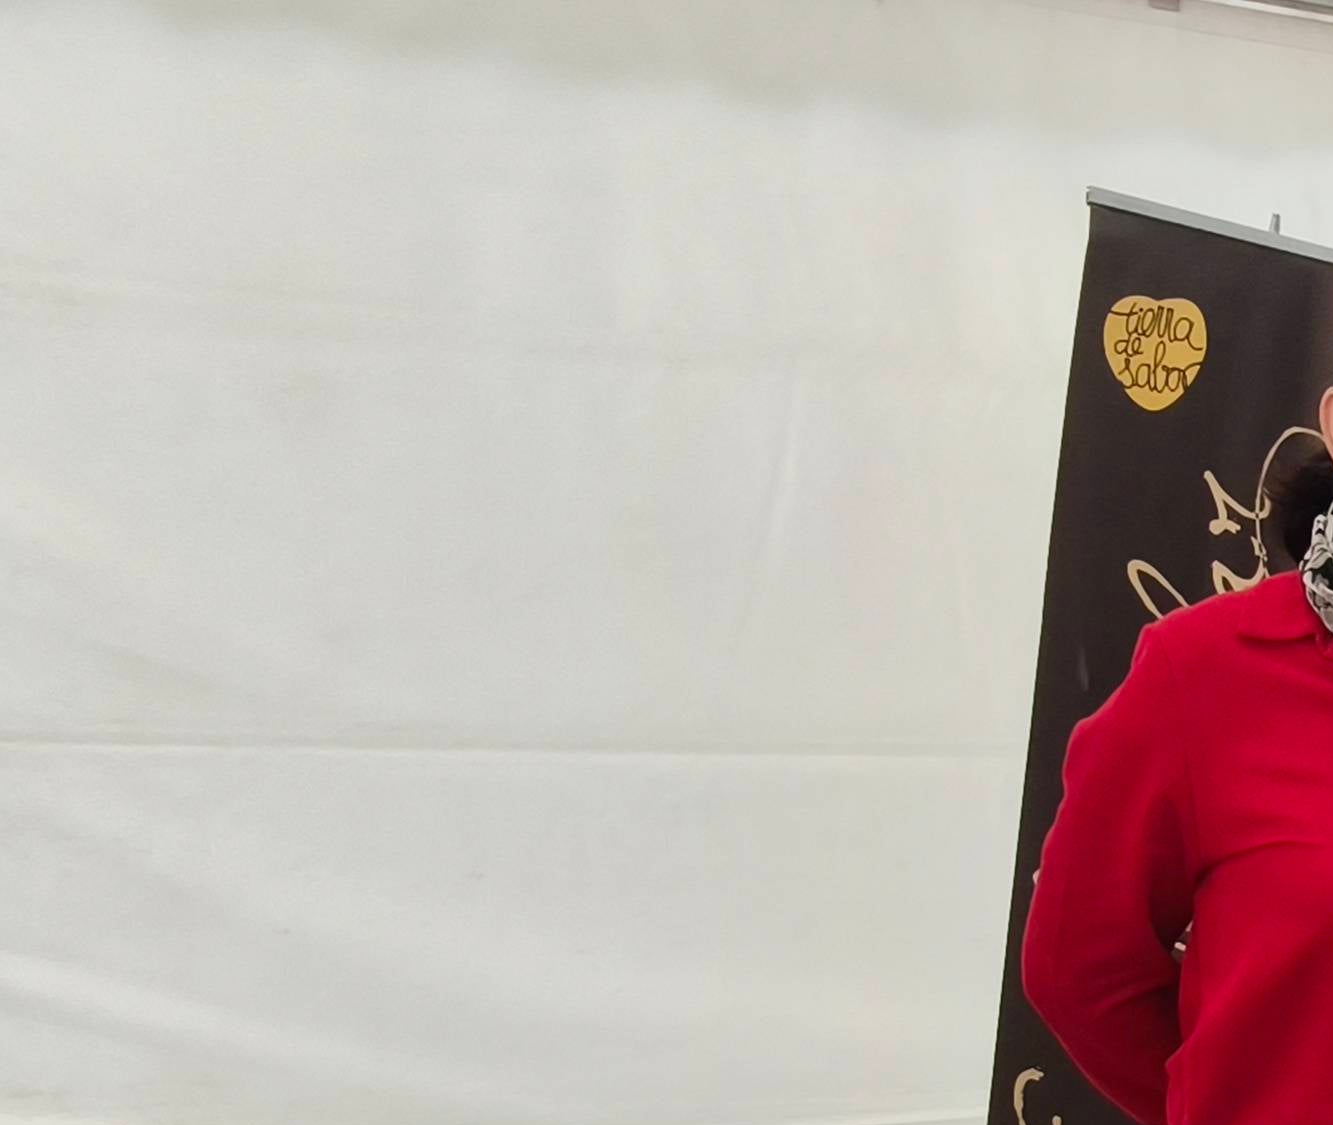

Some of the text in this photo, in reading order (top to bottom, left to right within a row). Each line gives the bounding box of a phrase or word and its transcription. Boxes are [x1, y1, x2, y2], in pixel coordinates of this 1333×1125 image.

[1110, 303, 1203, 350] tierra
[1114, 335, 1143, 357] de
[1118, 341, 1203, 393] sabor
